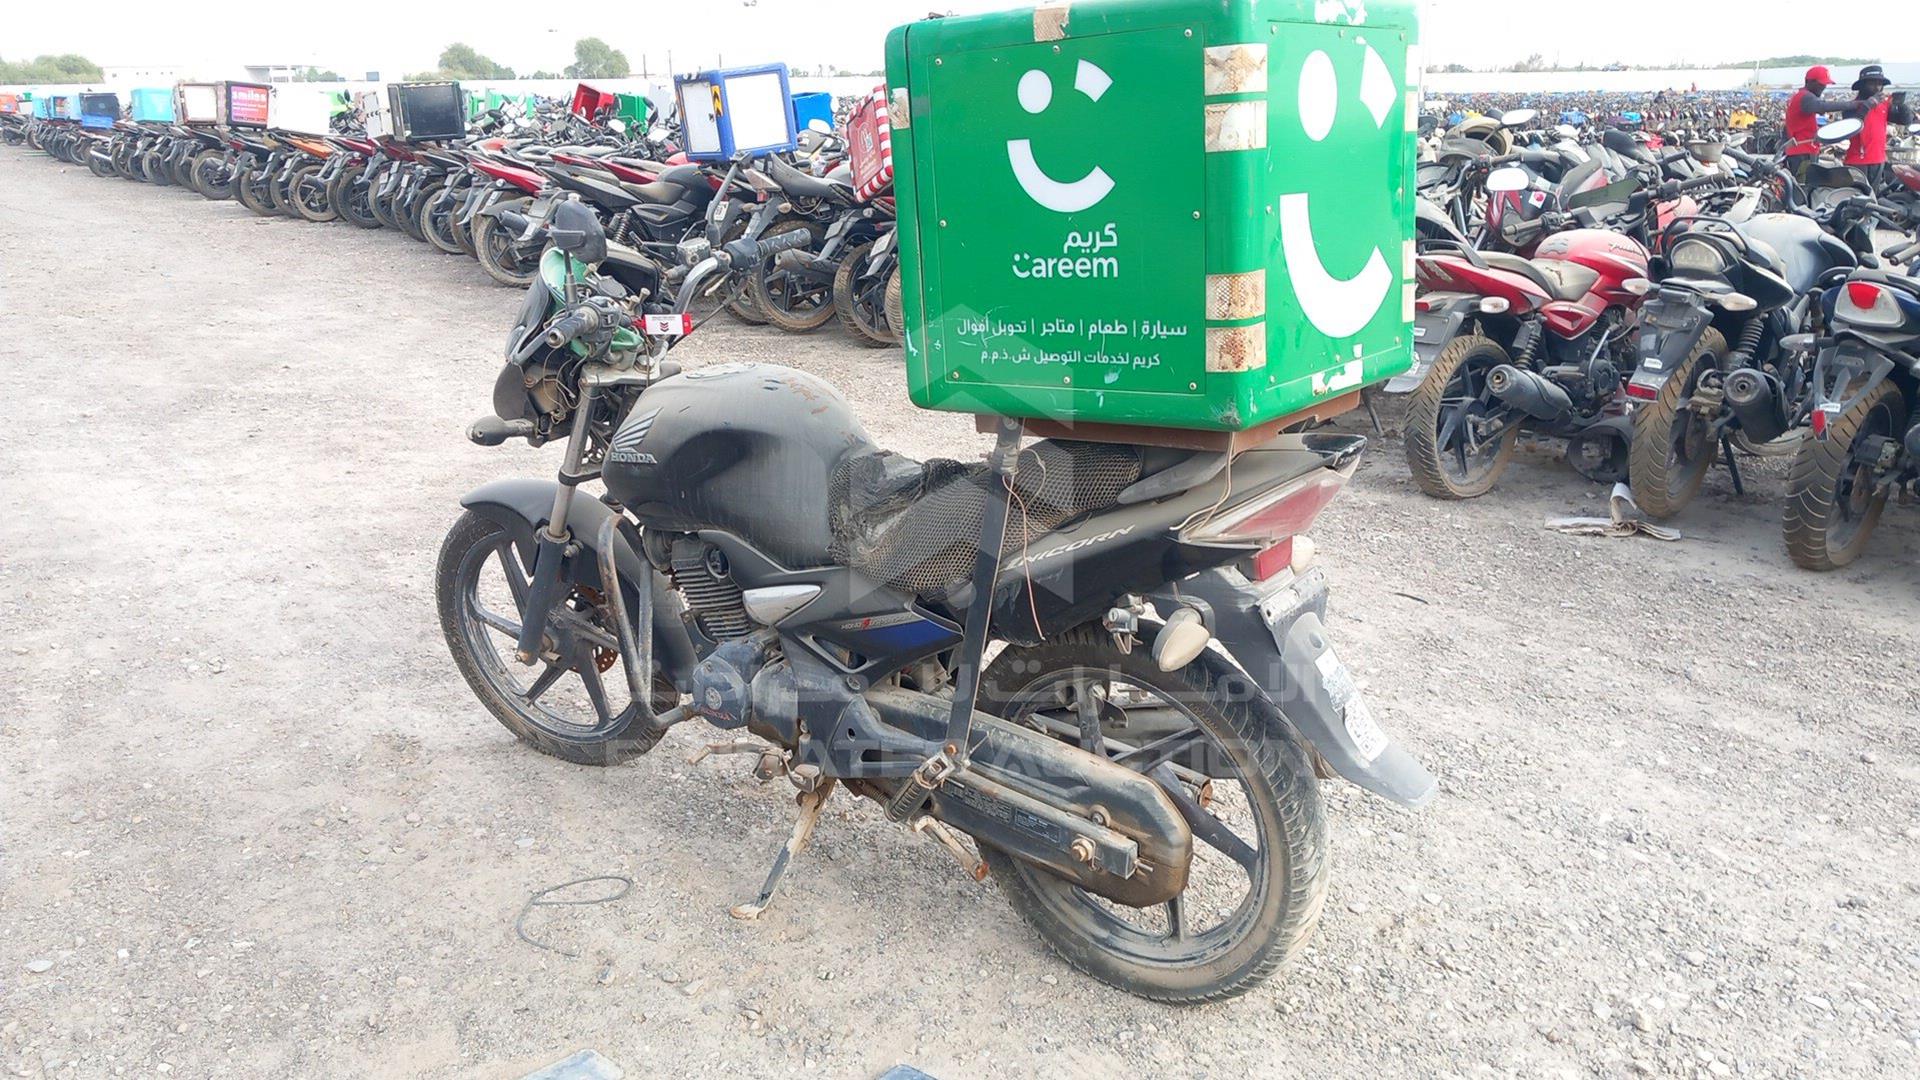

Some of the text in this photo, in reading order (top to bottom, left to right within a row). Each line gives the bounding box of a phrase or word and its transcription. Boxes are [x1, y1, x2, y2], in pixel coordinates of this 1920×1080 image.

[1063, 222, 1118, 254] كريم
[1012, 252, 1119, 279] Careem
[991, 319, 1027, 337] تحويل
[1040, 317, 1075, 337] متاجر
[1088, 318, 1128, 341] طعام
[1141, 319, 1187, 340] سيارة
[1033, 348, 1081, 366] التوصيل
[1083, 350, 1130, 365] لخدمات
[1132, 353, 1161, 371] كريم
[610, 451, 659, 465] HONDA
